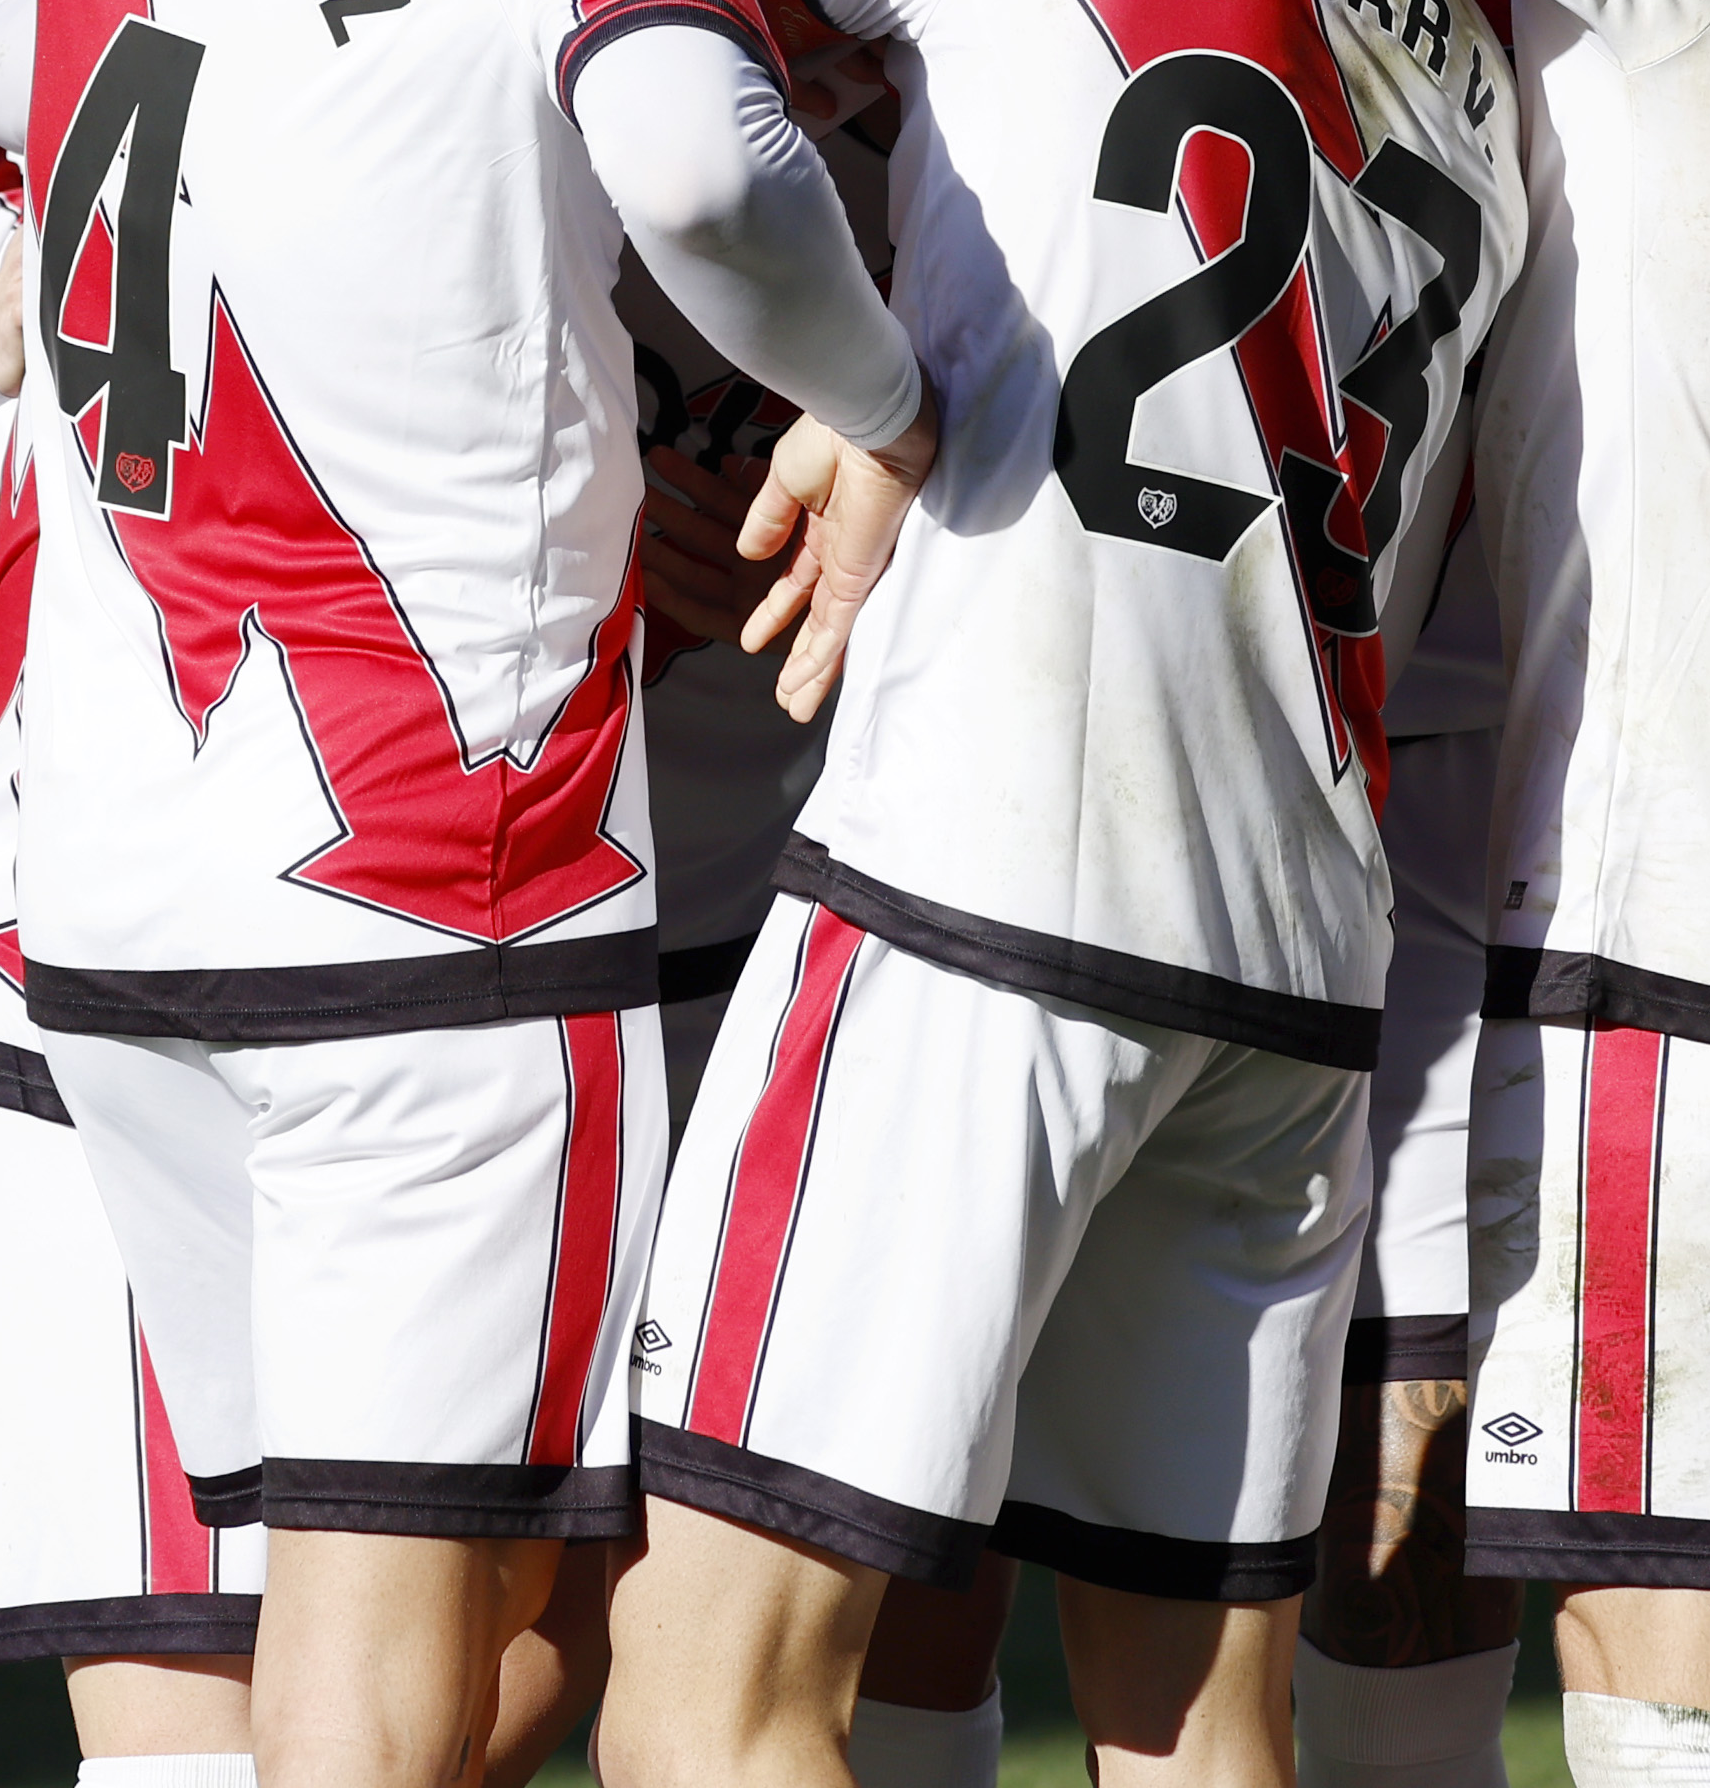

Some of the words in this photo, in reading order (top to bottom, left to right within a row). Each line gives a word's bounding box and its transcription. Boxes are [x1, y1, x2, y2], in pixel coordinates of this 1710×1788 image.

[40, 14, 207, 520] 4
[1053, 49, 1483, 638] 23
[630, 1353, 662, 1376] umbro
[1485, 1448, 1538, 1466] umbro
